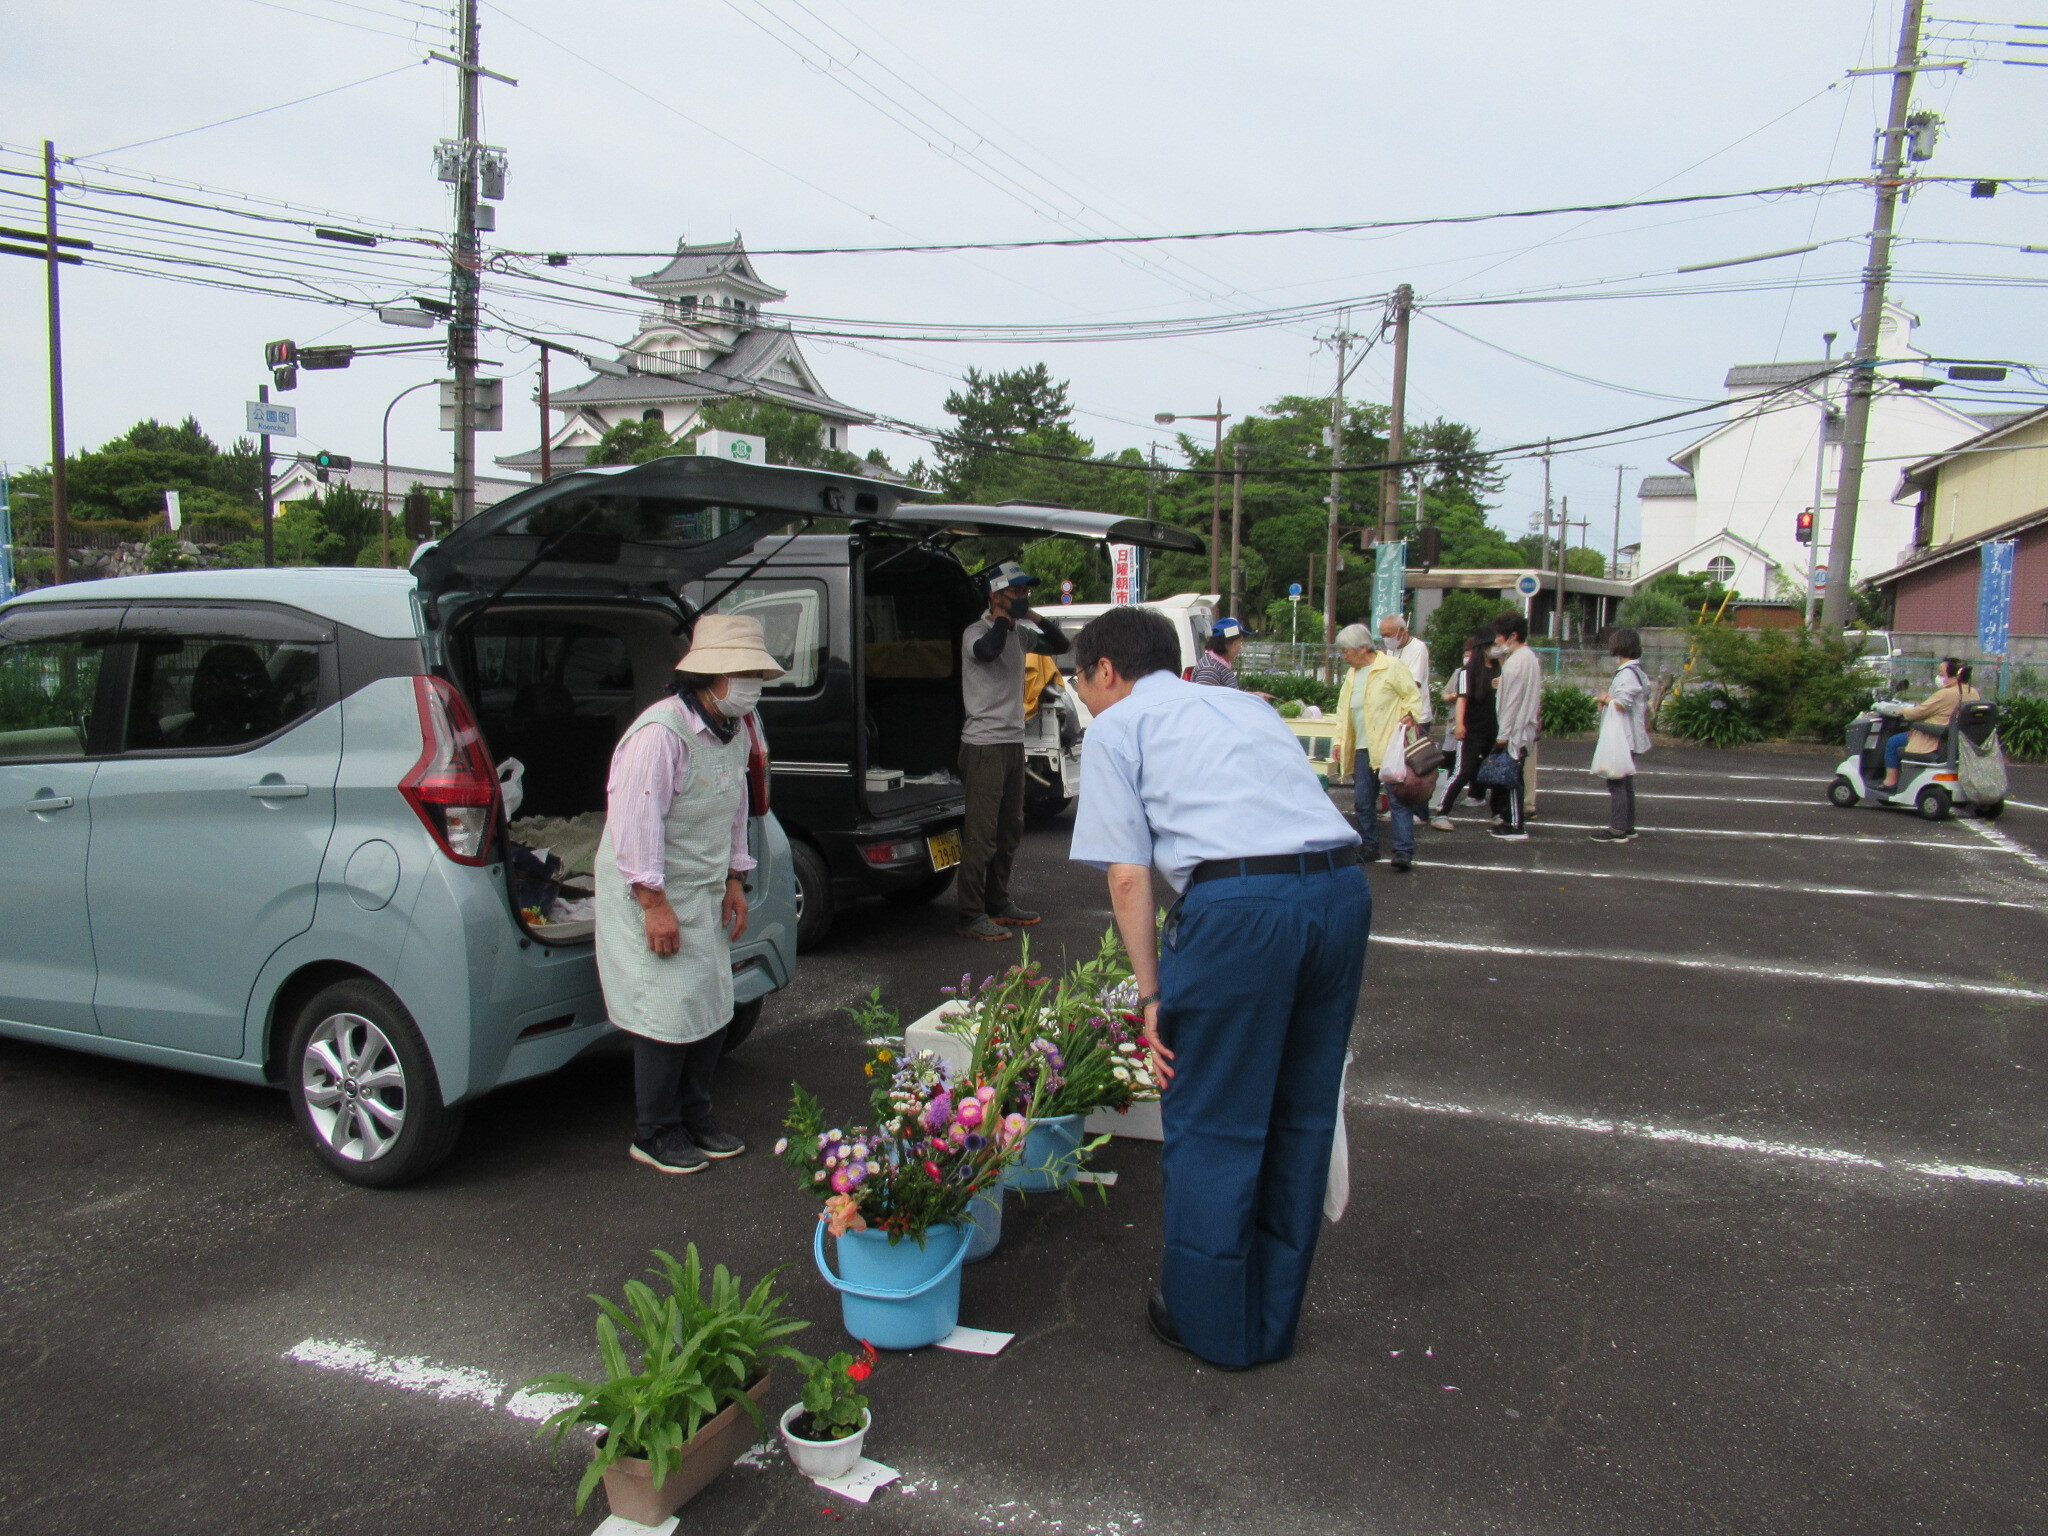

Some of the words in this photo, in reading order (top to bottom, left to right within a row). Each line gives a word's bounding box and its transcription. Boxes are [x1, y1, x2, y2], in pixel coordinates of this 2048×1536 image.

[253, 409, 290, 425] 公園町
[1116, 549, 1129, 604] 日曜朝市
